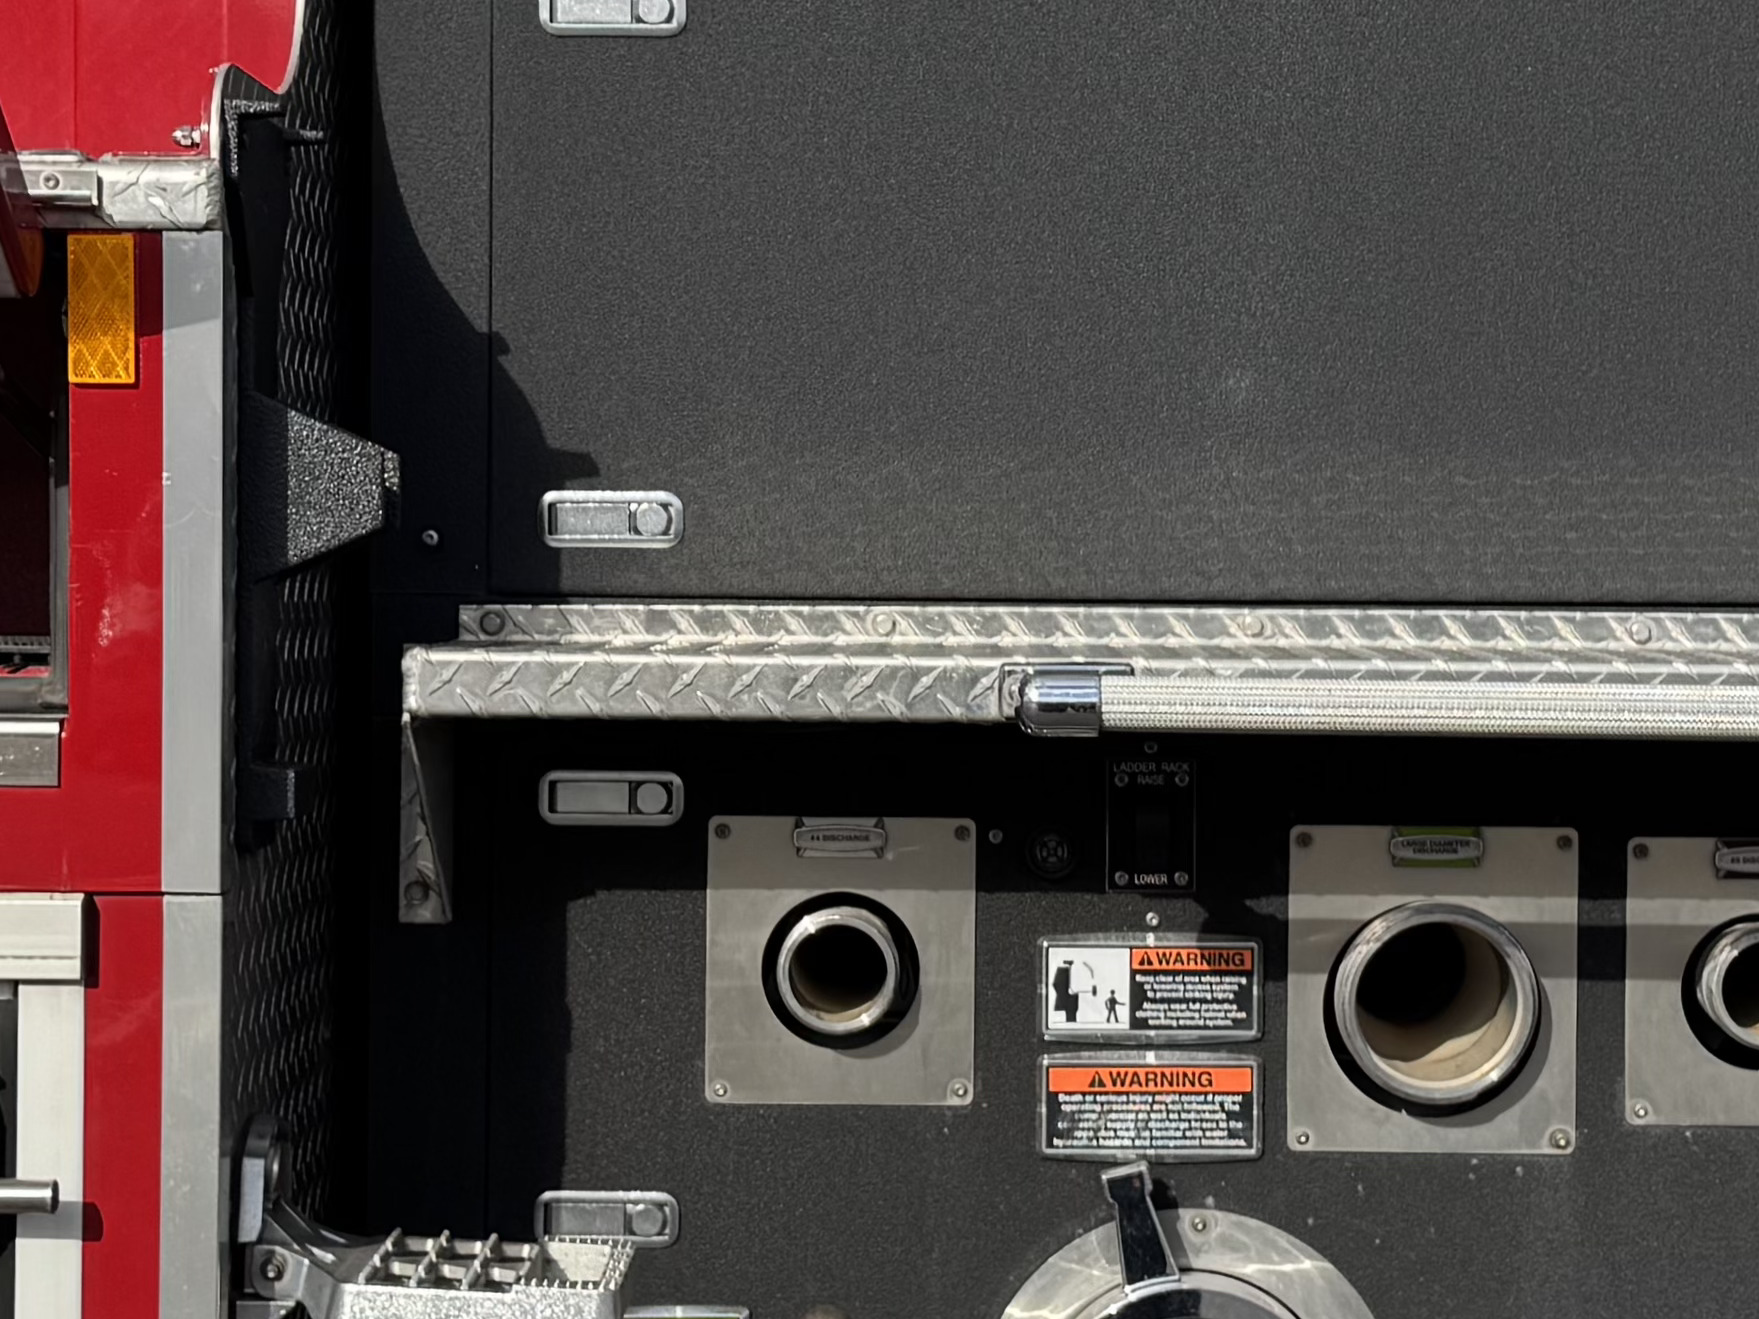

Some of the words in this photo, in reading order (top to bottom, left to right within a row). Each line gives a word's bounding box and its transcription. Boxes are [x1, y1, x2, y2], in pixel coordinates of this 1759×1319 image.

[1113, 761, 1156, 772] LADDER
[1134, 873, 1168, 885] LOWER
[1156, 951, 1245, 967] WARNING
[1108, 1071, 1213, 1088] WARNING
